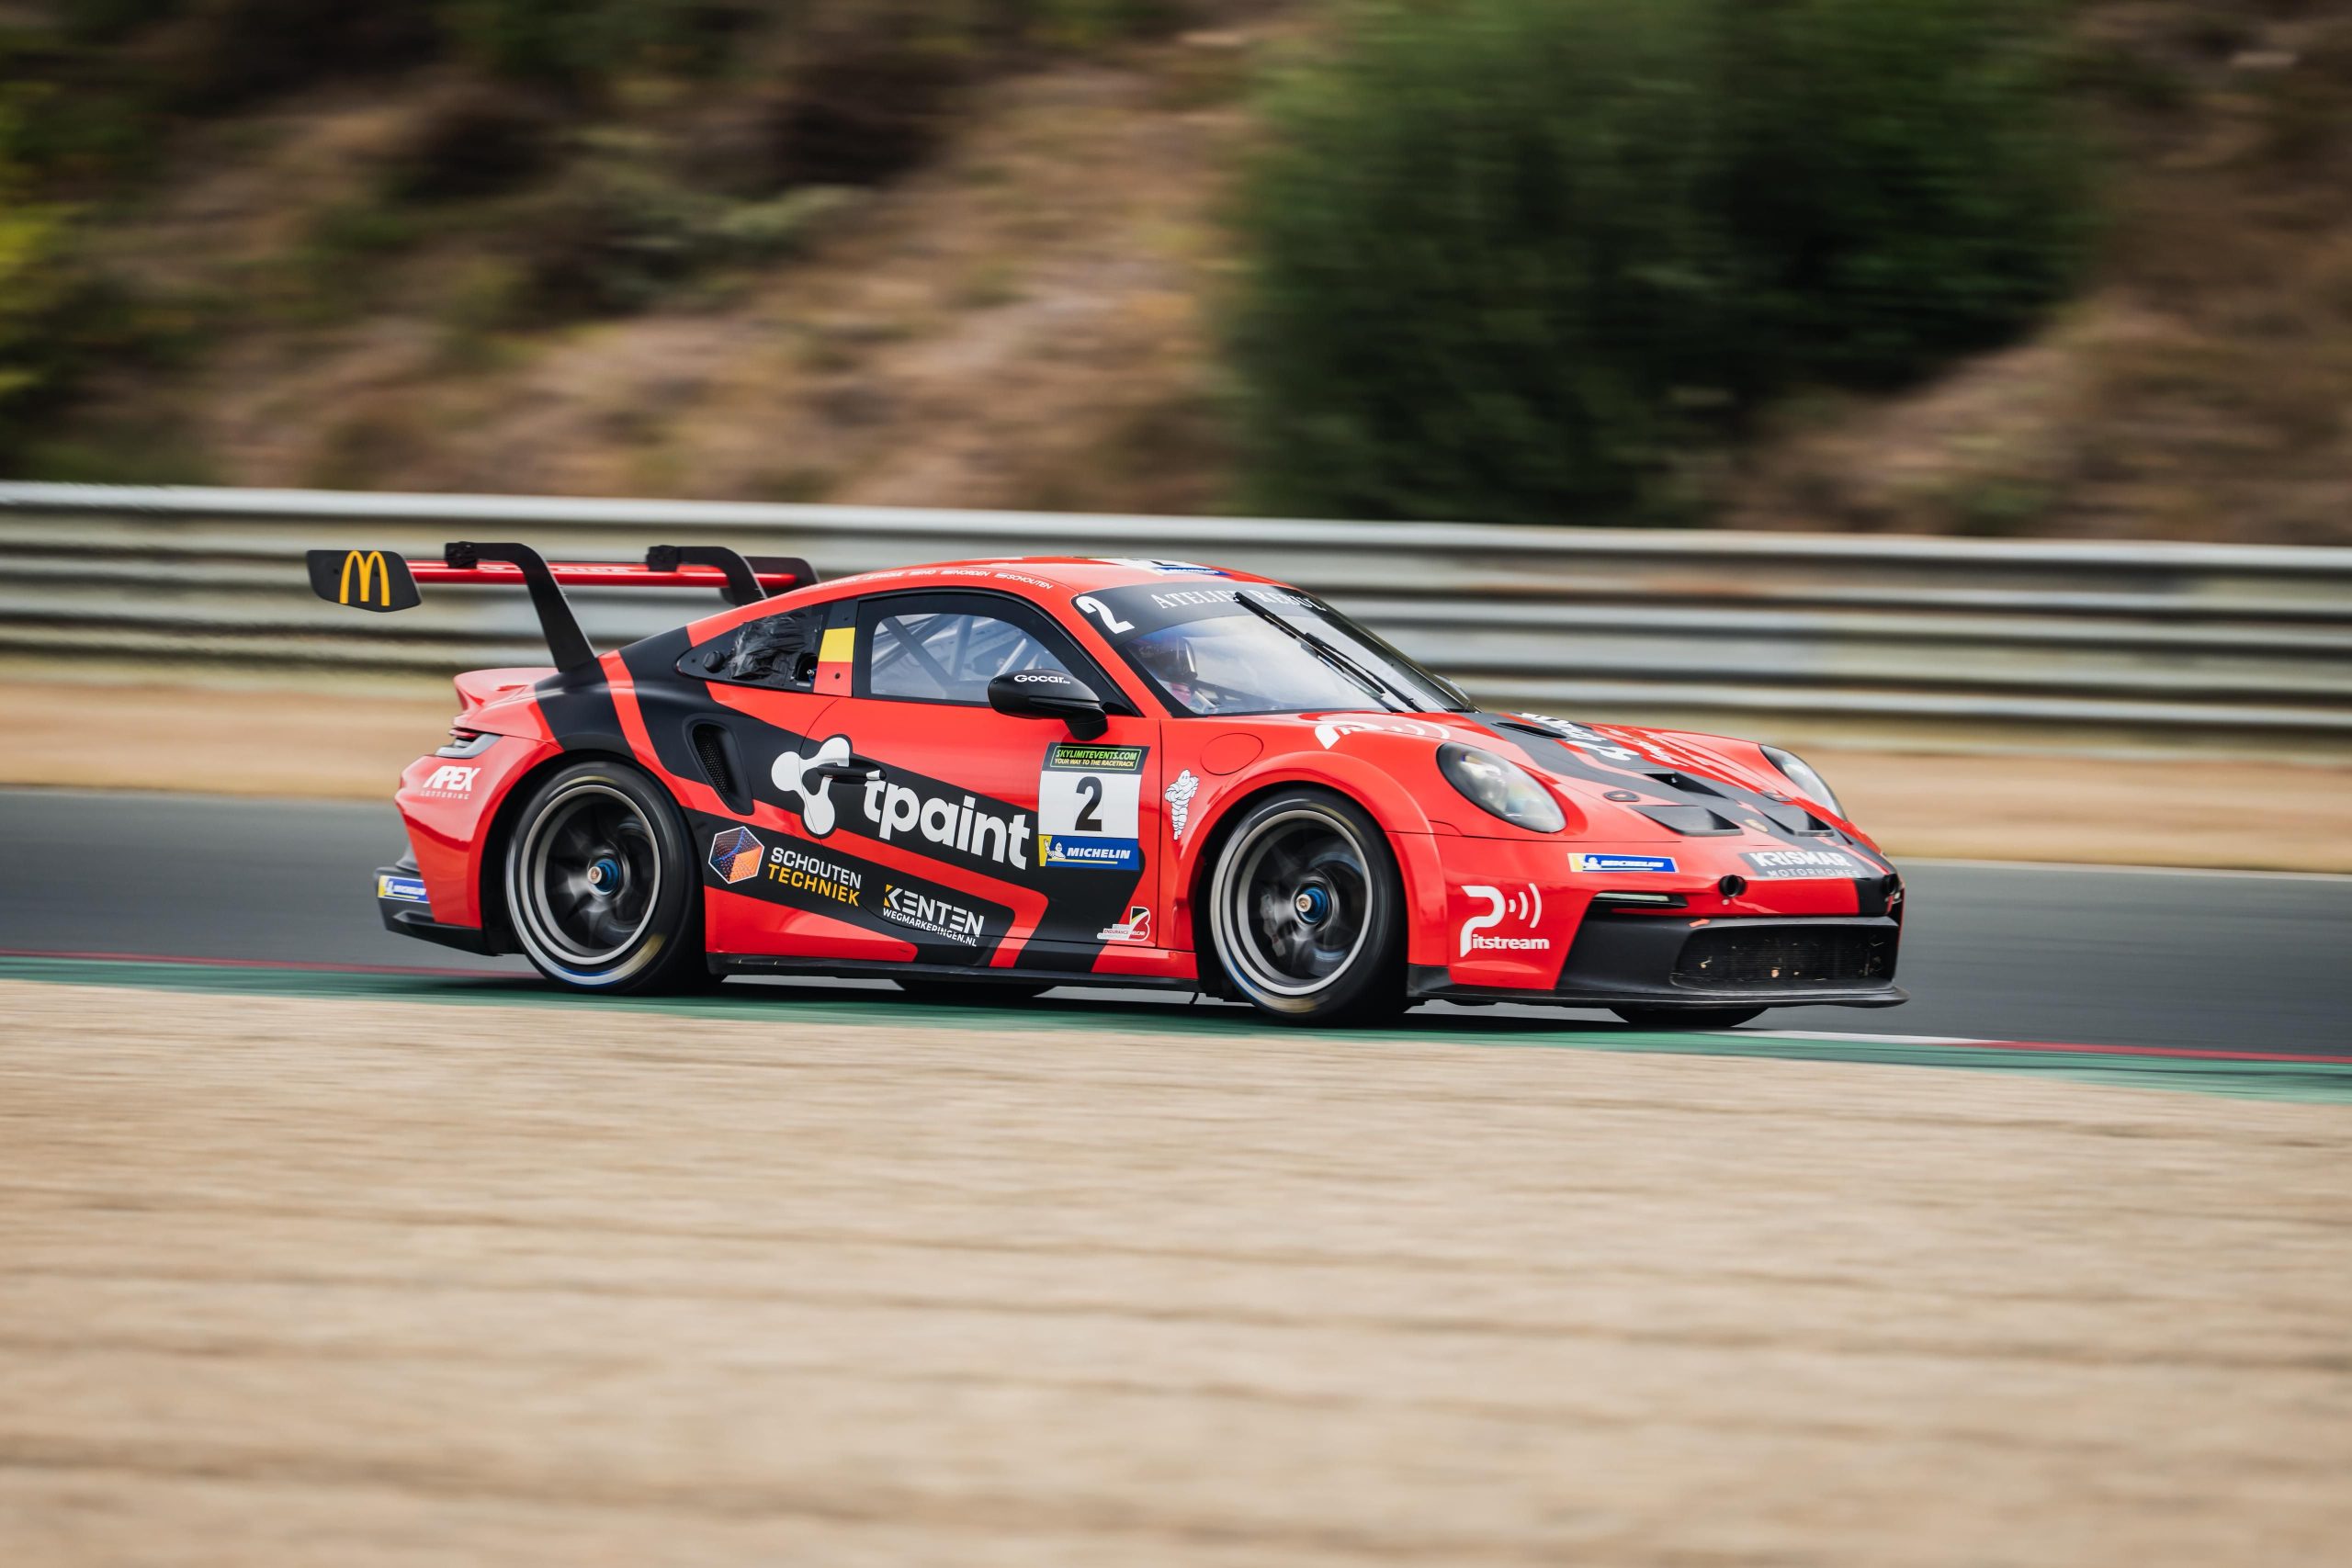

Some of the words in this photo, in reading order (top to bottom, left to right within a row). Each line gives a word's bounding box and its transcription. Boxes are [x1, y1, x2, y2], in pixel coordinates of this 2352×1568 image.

[1006, 573, 1054, 590] SCHOUTEN
[1150, 590, 1240, 609] ATELIE
[1076, 595, 1136, 635] 2
[1056, 749, 1138, 761] SKYLIMITEVENTS.COM
[423, 765, 481, 792] APEX
[863, 769, 1031, 871] tpaint
[1074, 775, 1102, 832] 2
[770, 846, 862, 890] SCHOUTEN
[1067, 847, 1131, 860] MICHELIN
[1748, 851, 1853, 867] KRISMAR
[767, 863, 861, 908] TECHNIEK
[882, 908, 978, 948] WEGMARKERINGEN.NL
[883, 884, 985, 938] KENTEN
